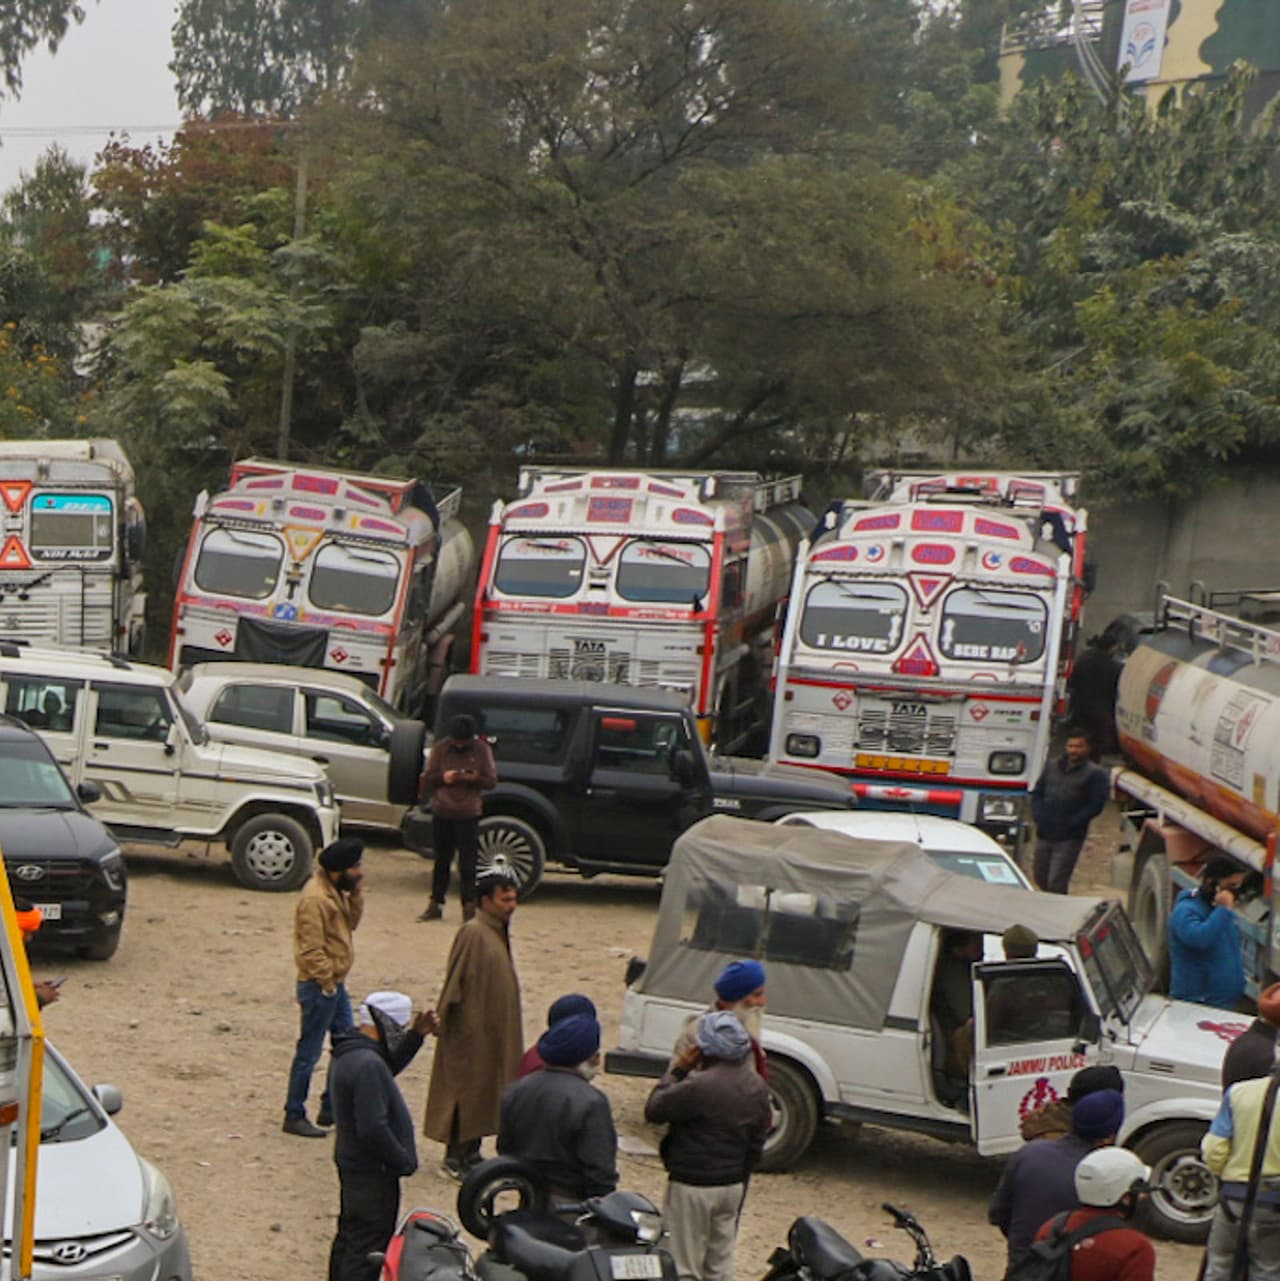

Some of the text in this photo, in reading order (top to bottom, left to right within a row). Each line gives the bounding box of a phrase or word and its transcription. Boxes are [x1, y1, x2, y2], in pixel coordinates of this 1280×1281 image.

[574, 640, 607, 651] TATA
[832, 634, 888, 651] LOVE
[891, 702, 927, 716] TATA
